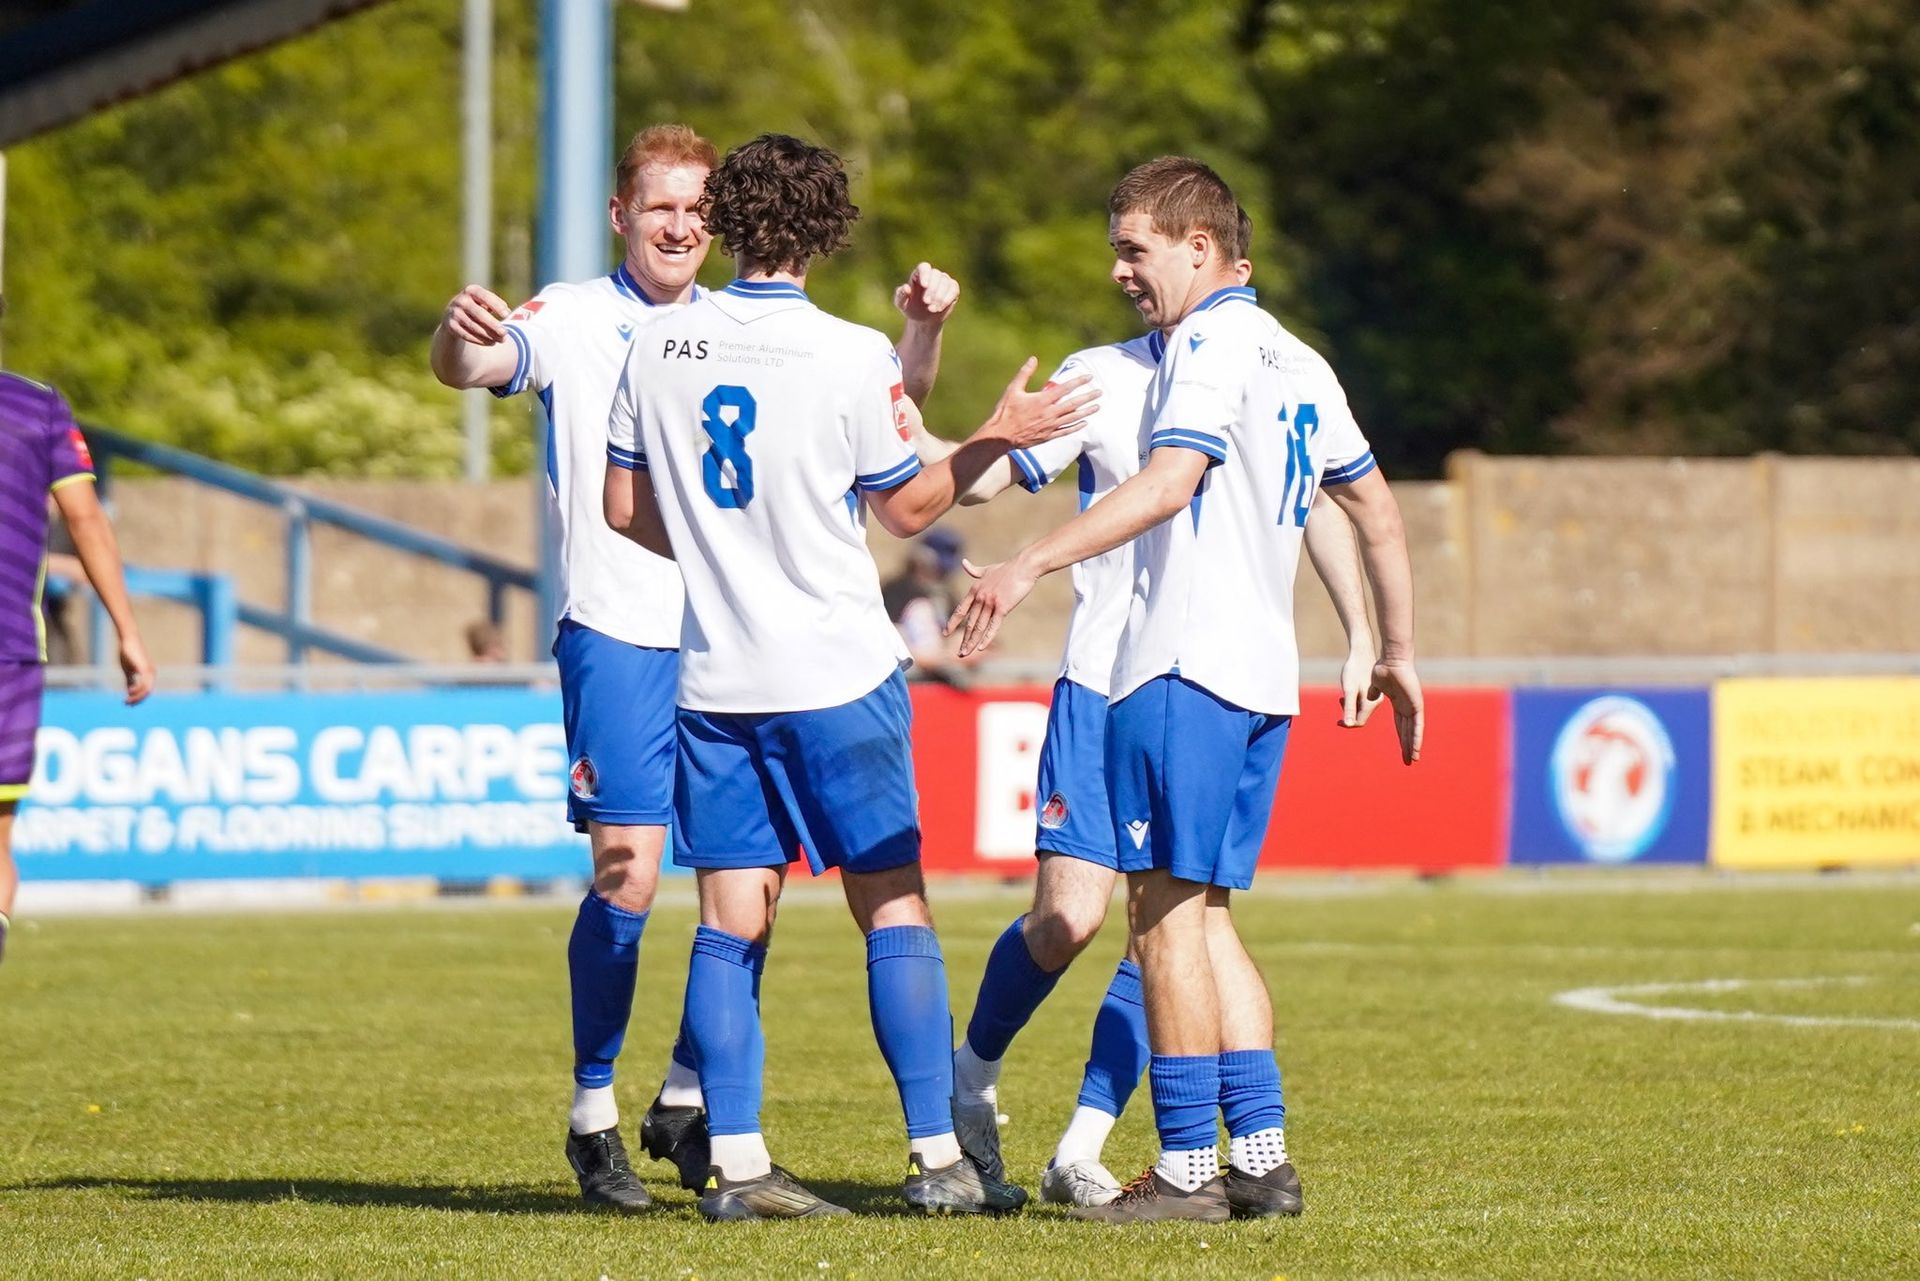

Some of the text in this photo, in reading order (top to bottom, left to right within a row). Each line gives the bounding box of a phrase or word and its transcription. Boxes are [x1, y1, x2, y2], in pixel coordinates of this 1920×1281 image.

[663, 339, 814, 360] PAS Premier Aluminium
[716, 352, 784, 368] Solutions LTD
[702, 385, 757, 510] 8
[1277, 401, 1319, 528] 16
[138, 806, 174, 853] &
[179, 804, 385, 849] FLOORING
